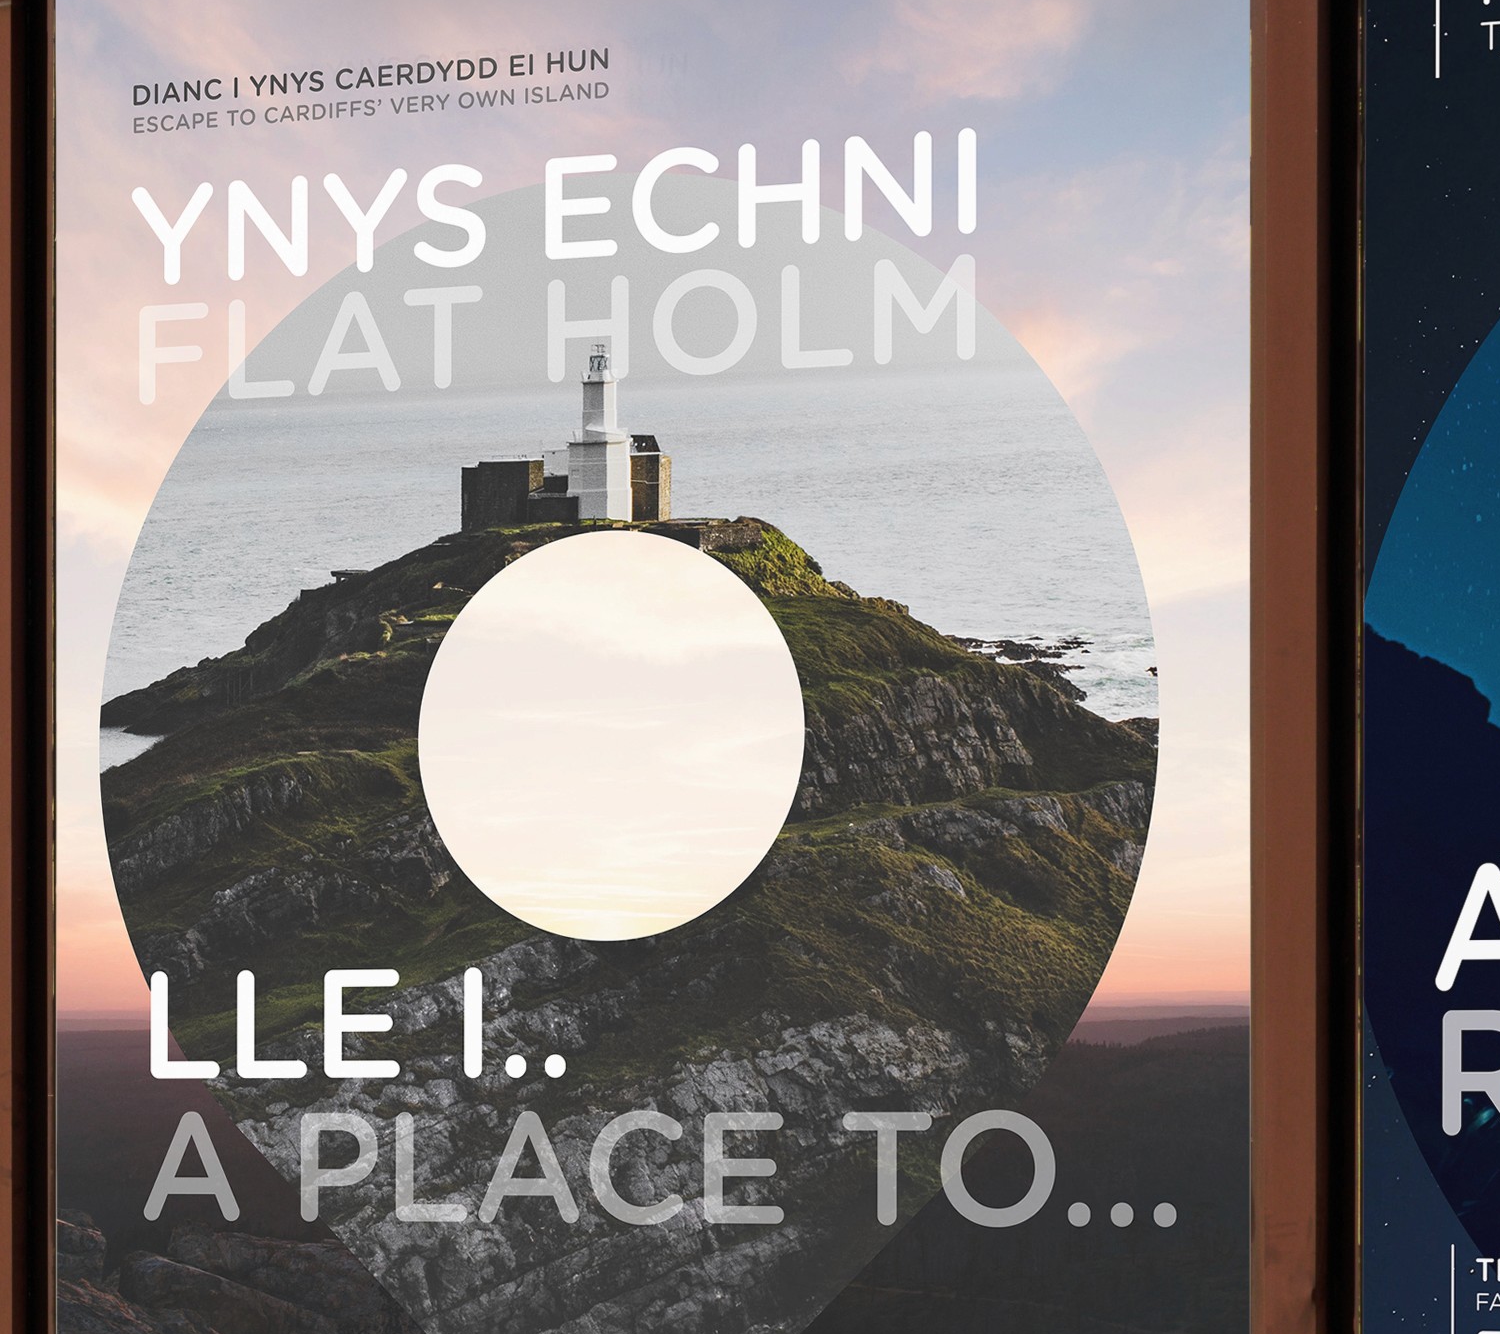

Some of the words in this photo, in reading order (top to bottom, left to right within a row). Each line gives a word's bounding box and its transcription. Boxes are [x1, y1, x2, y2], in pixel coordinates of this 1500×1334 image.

[133, 79, 222, 106] DIANC
[234, 76, 239, 98] I
[249, 70, 325, 97] YNYS
[335, 57, 498, 90] CAERDYDD
[510, 53, 534, 77] EI
[547, 48, 610, 74] HUN
[133, 110, 218, 134] ESCAPE
[226, 107, 255, 127] TO
[391, 93, 450, 116] VERY
[458, 88, 516, 110] OWN
[525, 82, 610, 106] ISLAND
[131, 163, 487, 286] YNYS
[544, 127, 978, 260] ECHNI
[139, 284, 484, 406] FLAT
[546, 254, 976, 384] HOLM
[150, 968, 401, 1080] LLE
[463, 966, 567, 1079] I..
[143, 1110, 241, 1223] A
[300, 1110, 785, 1226] PLACE
[842, 1109, 1178, 1229] TO...
